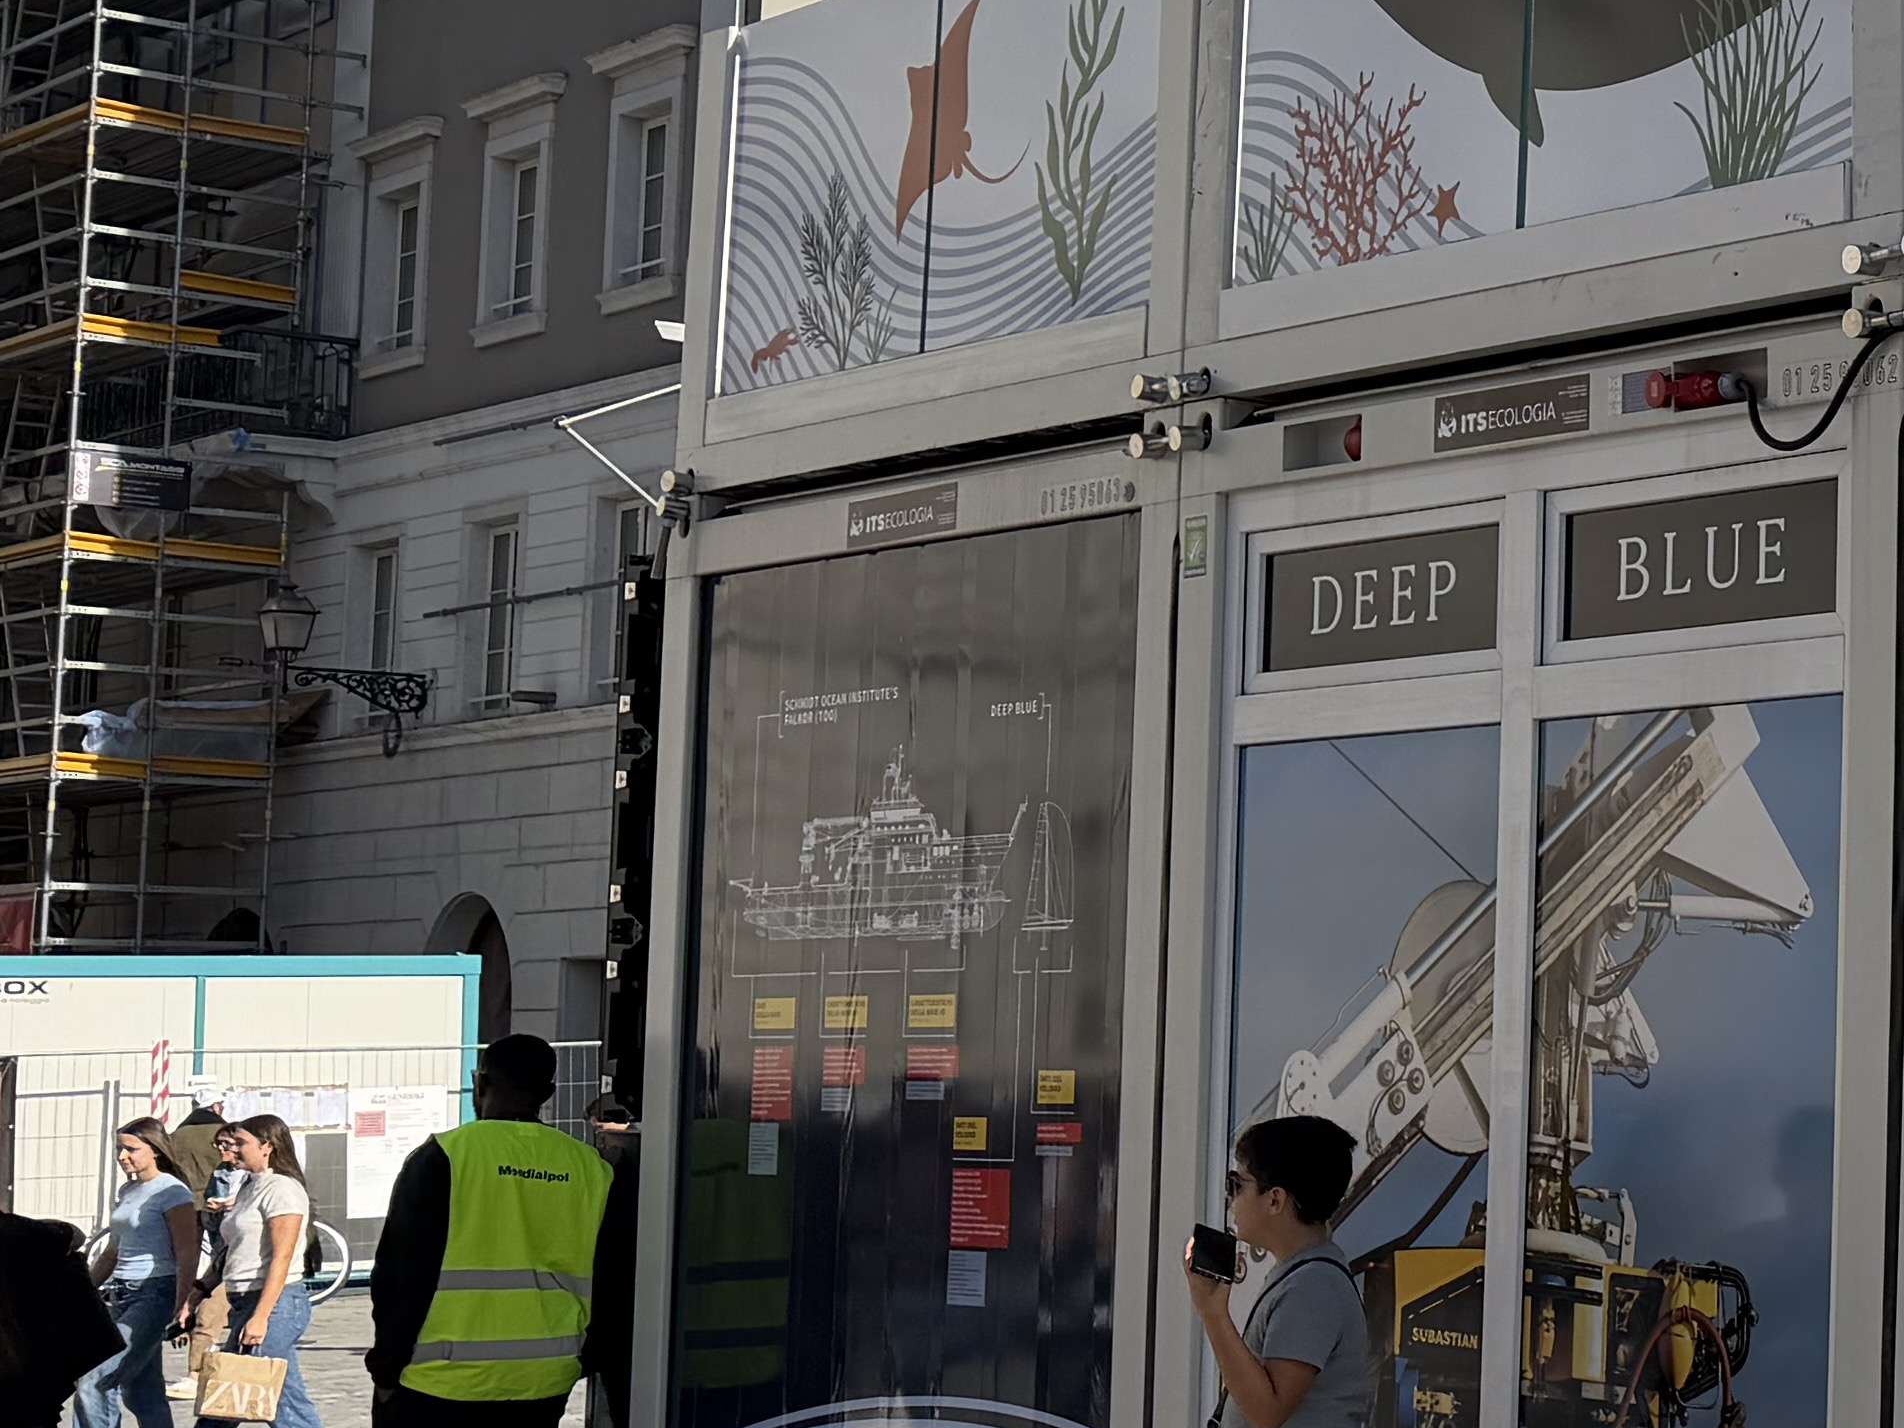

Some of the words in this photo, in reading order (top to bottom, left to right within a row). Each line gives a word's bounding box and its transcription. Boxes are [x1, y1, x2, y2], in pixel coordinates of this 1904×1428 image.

[1460, 402, 1557, 434] ITSECOLOGIA
[865, 505, 934, 533] ITSECOLOGIA
[1310, 560, 1457, 635] DEEP
[1616, 517, 1786, 601] BLUE
[990, 703, 1014, 718] DEEP
[1015, 699, 1038, 715] BLUE
[0, 980, 48, 995] OX
[498, 1165, 569, 1182] Mondialpol
[1412, 1327, 1478, 1349] SUBASTIAN
